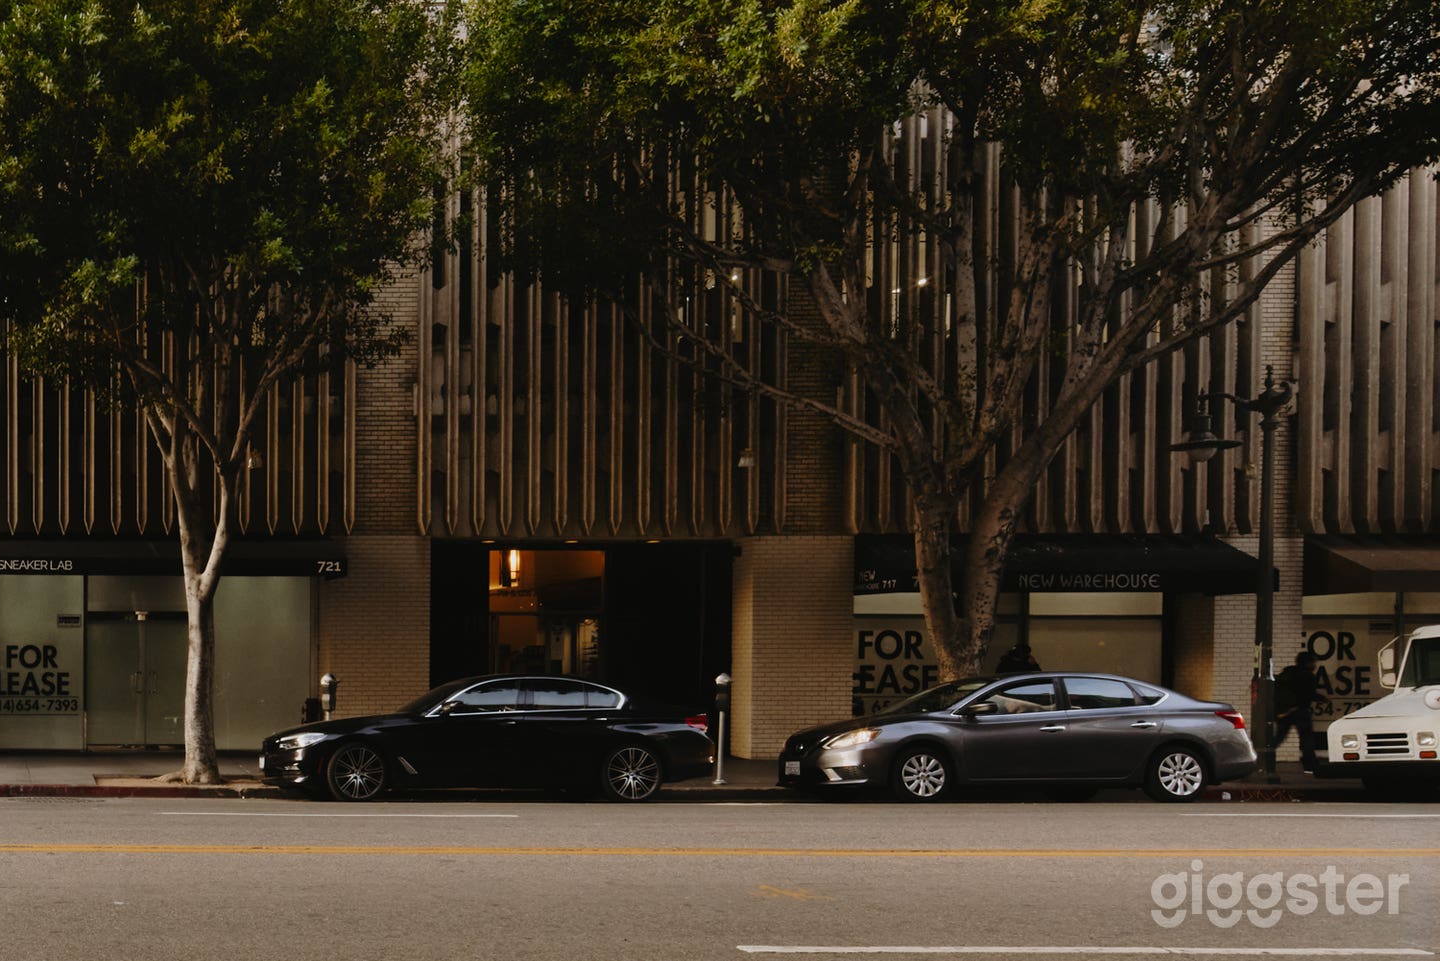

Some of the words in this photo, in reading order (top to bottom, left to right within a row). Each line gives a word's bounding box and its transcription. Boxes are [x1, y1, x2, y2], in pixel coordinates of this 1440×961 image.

[50, 559, 73, 571] LAB
[317, 561, 342, 573] 721
[882, 579, 897, 589] 717
[1019, 574, 1055, 589] NEW
[1061, 573, 1160, 589] WAREHOUSE
[6, 644, 58, 669] FOR
[858, 630, 923, 660] FOR
[1301, 631, 1356, 661] OR
[853, 664, 938, 695] EASE
[1313, 665, 1371, 696] ASE
